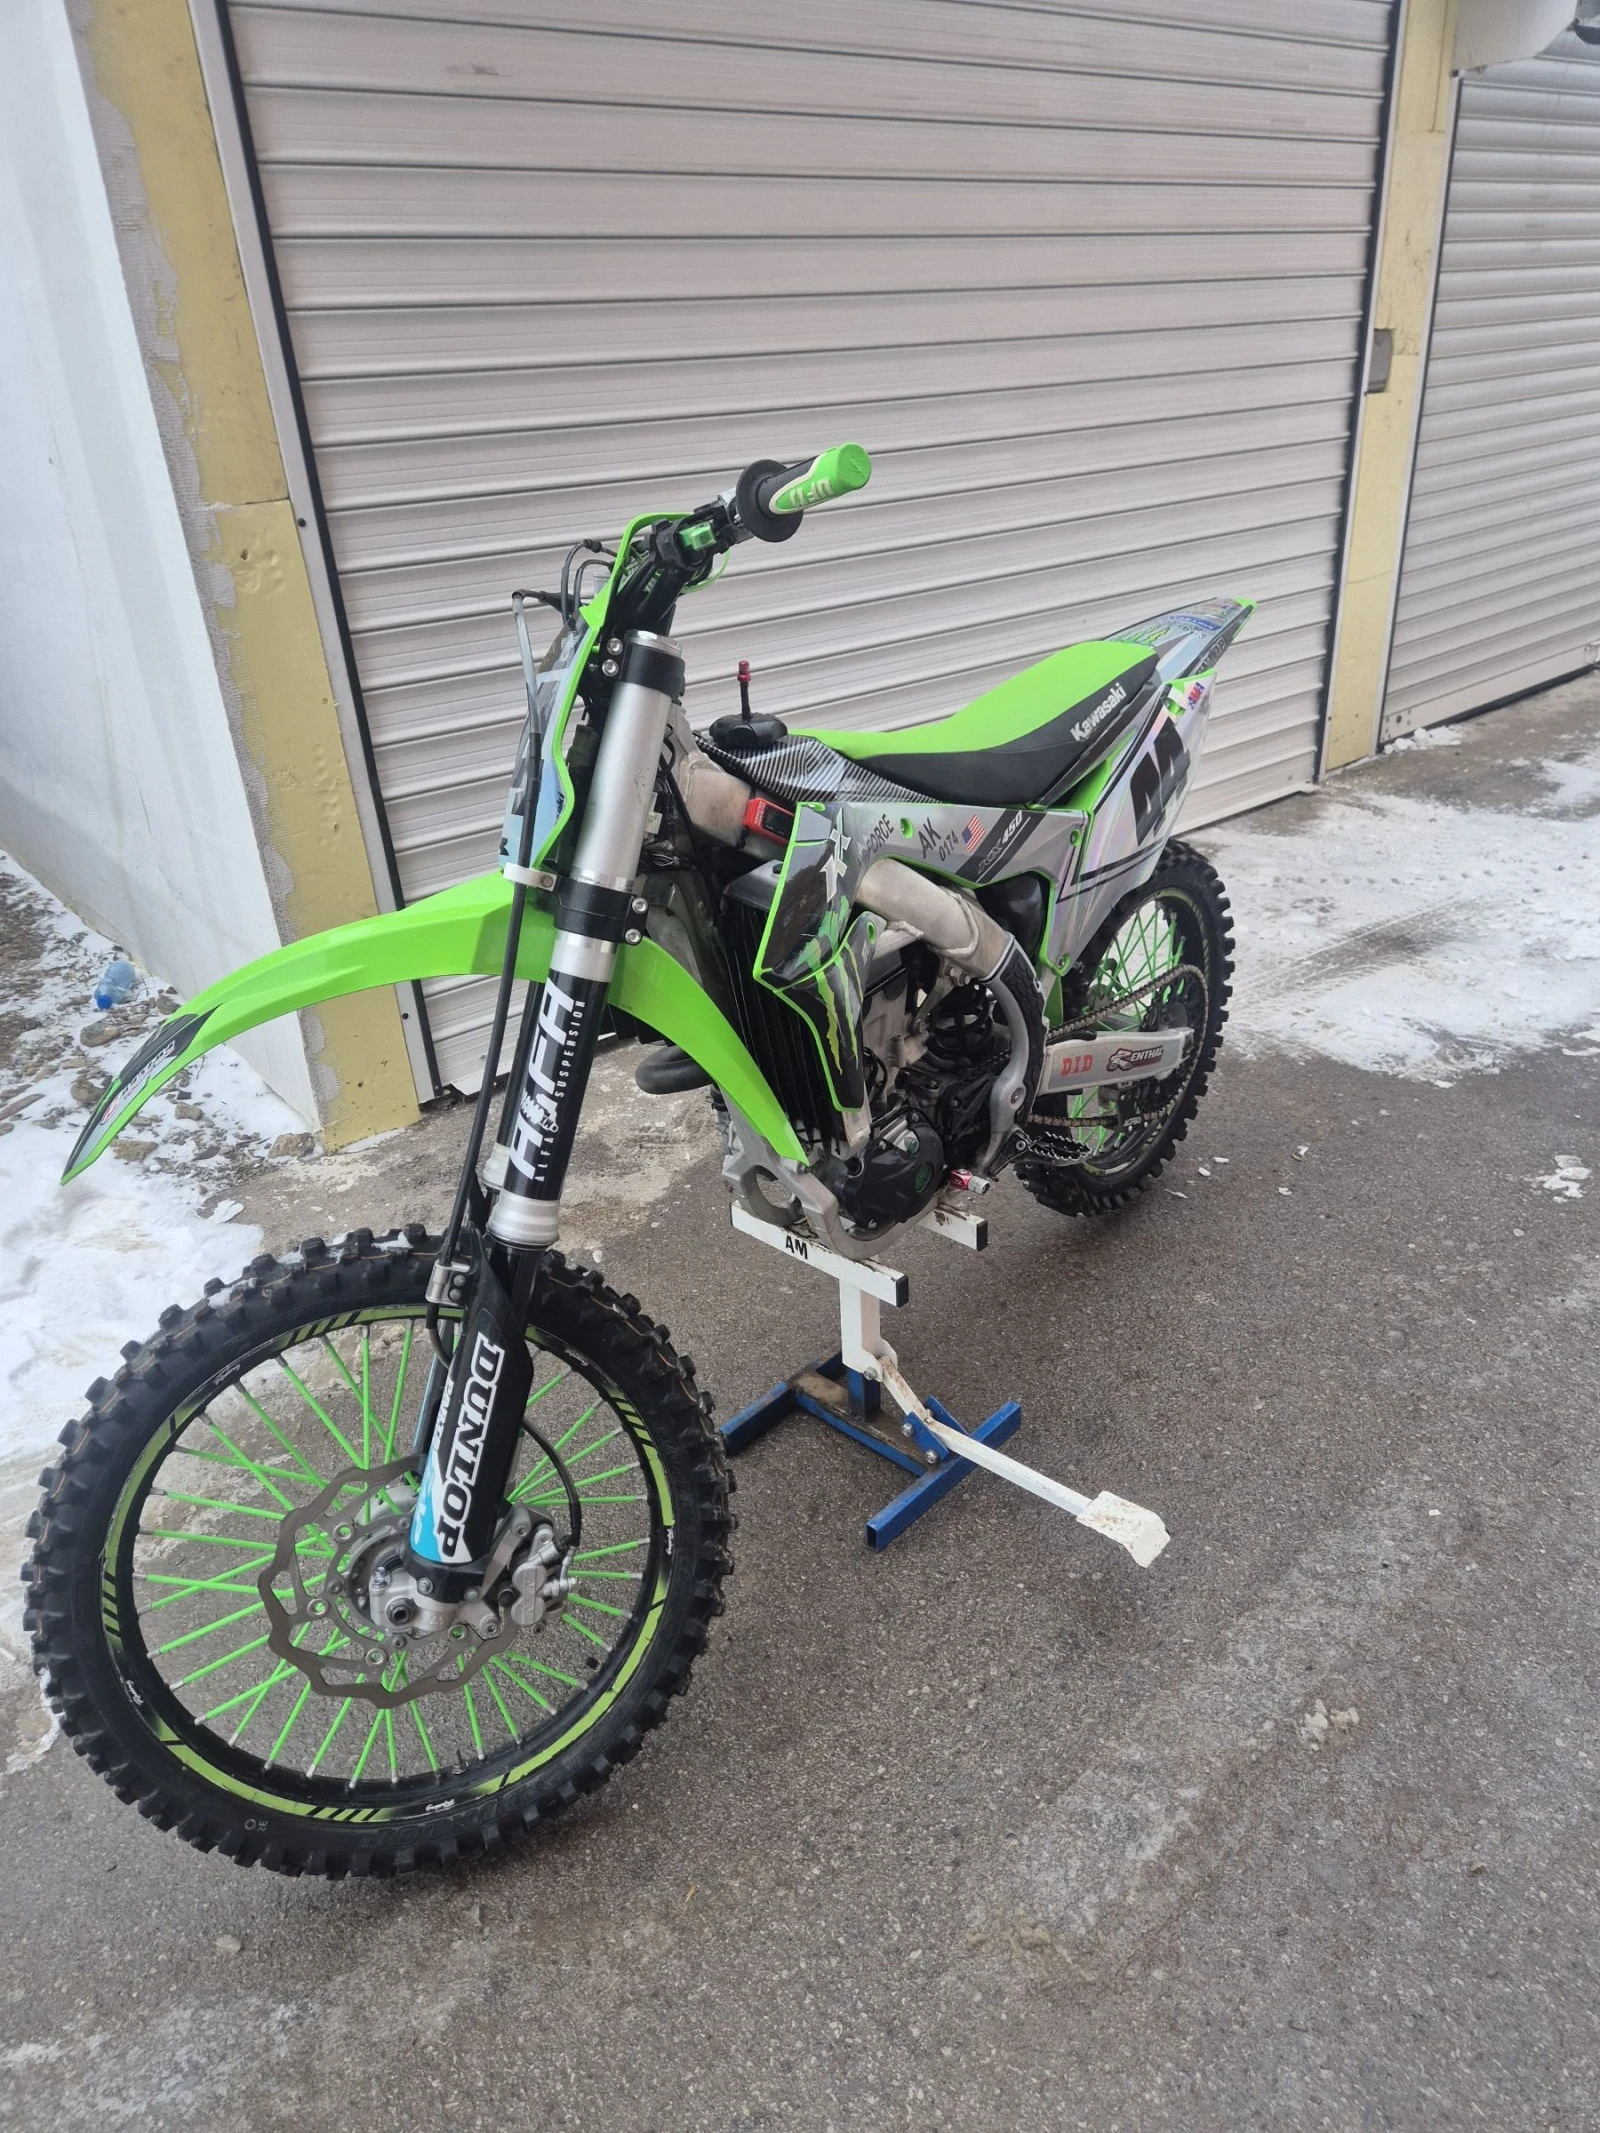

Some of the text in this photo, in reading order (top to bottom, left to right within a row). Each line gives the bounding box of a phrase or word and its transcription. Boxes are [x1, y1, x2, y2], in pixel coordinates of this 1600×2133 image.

[1070, 682, 1126, 741] Kawasaki
[918, 816, 942, 859] AK
[938, 829, 959, 861] 0174
[1002, 810, 1023, 844] 450
[1106, 1046, 1164, 1072] RENTHAL
[534, 1000, 586, 1182] ALFA SUSPENSION
[785, 1235, 808, 1260] AM
[437, 1332, 505, 1558] DUNLOP
